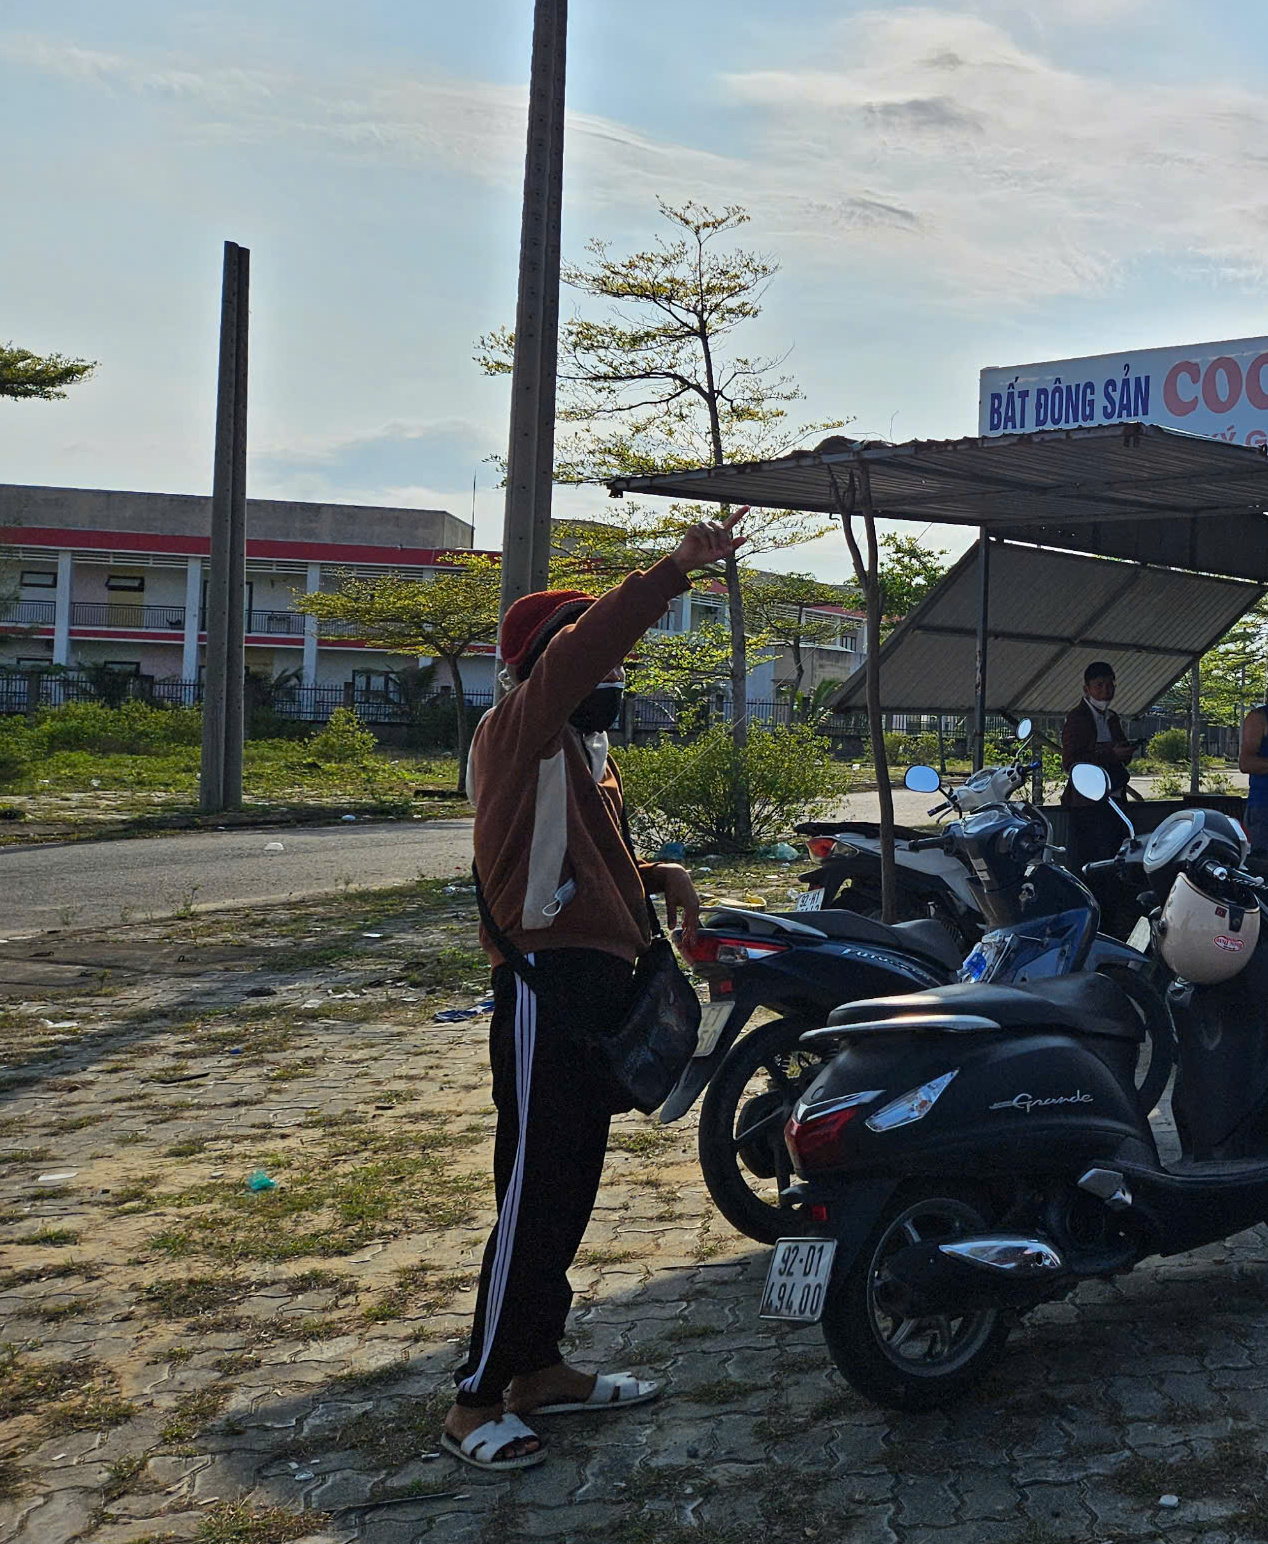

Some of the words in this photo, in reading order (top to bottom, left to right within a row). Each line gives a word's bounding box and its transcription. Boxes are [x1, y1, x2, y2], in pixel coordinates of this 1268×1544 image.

[989, 376, 1030, 431] BẤT
[1102, 363, 1151, 420] SẢN
[995, 1089, 1094, 1114] Grande
[778, 1244, 825, 1278] 92-D1
